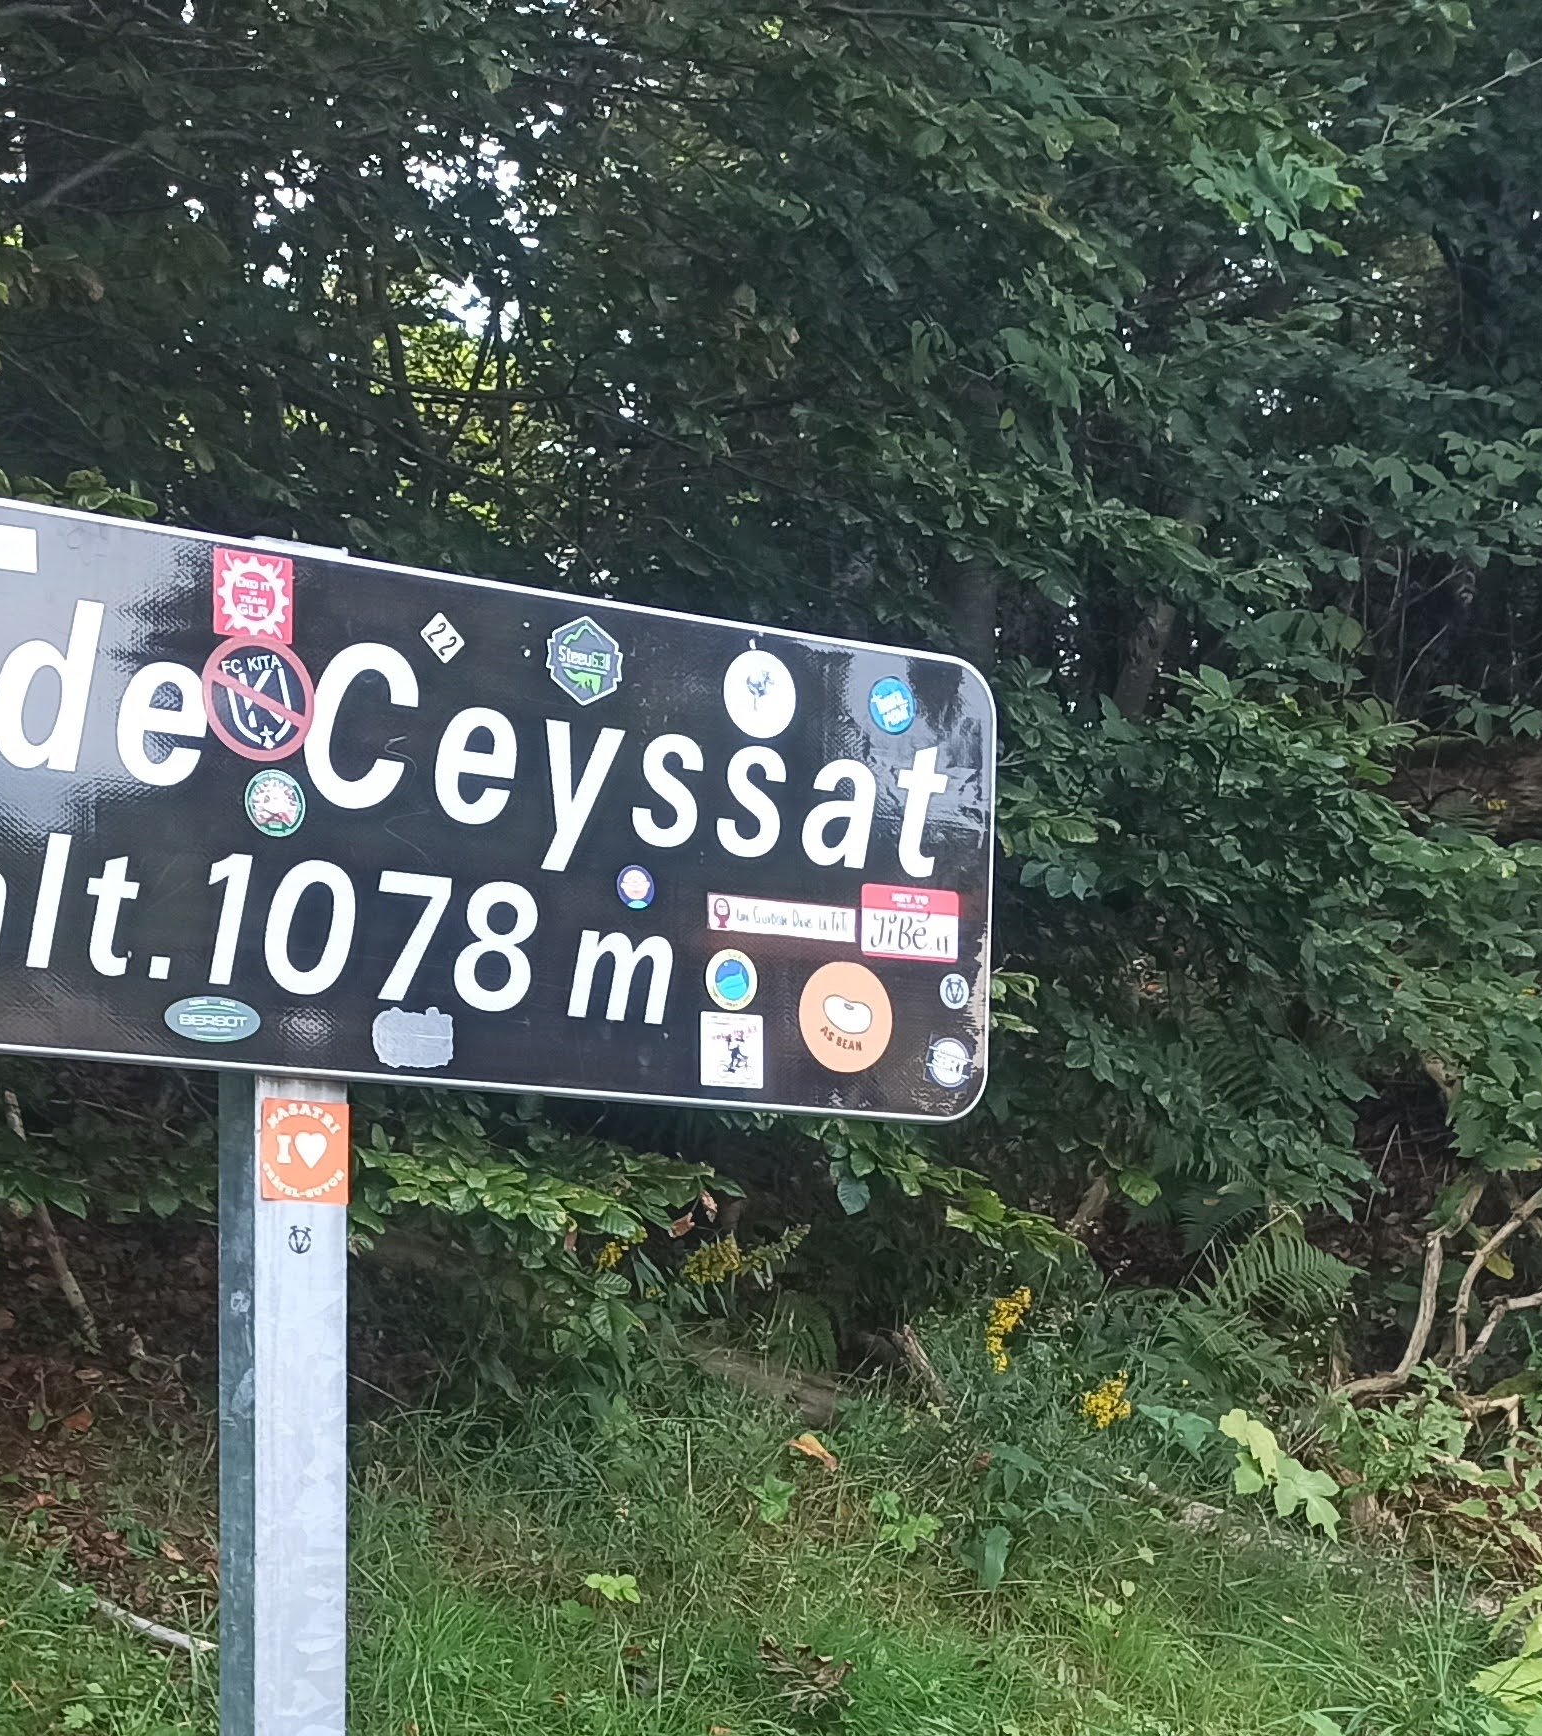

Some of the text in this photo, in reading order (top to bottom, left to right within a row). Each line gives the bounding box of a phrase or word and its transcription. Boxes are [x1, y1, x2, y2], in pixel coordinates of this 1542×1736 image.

[221, 654, 283, 675] FC KITA
[303, 642, 949, 878] Ceyssat
[208, 852, 539, 1012] 1078
[566, 929, 674, 1025] m
[819, 1025, 863, 1052] AS BEAN
[276, 1133, 293, 1165] I
